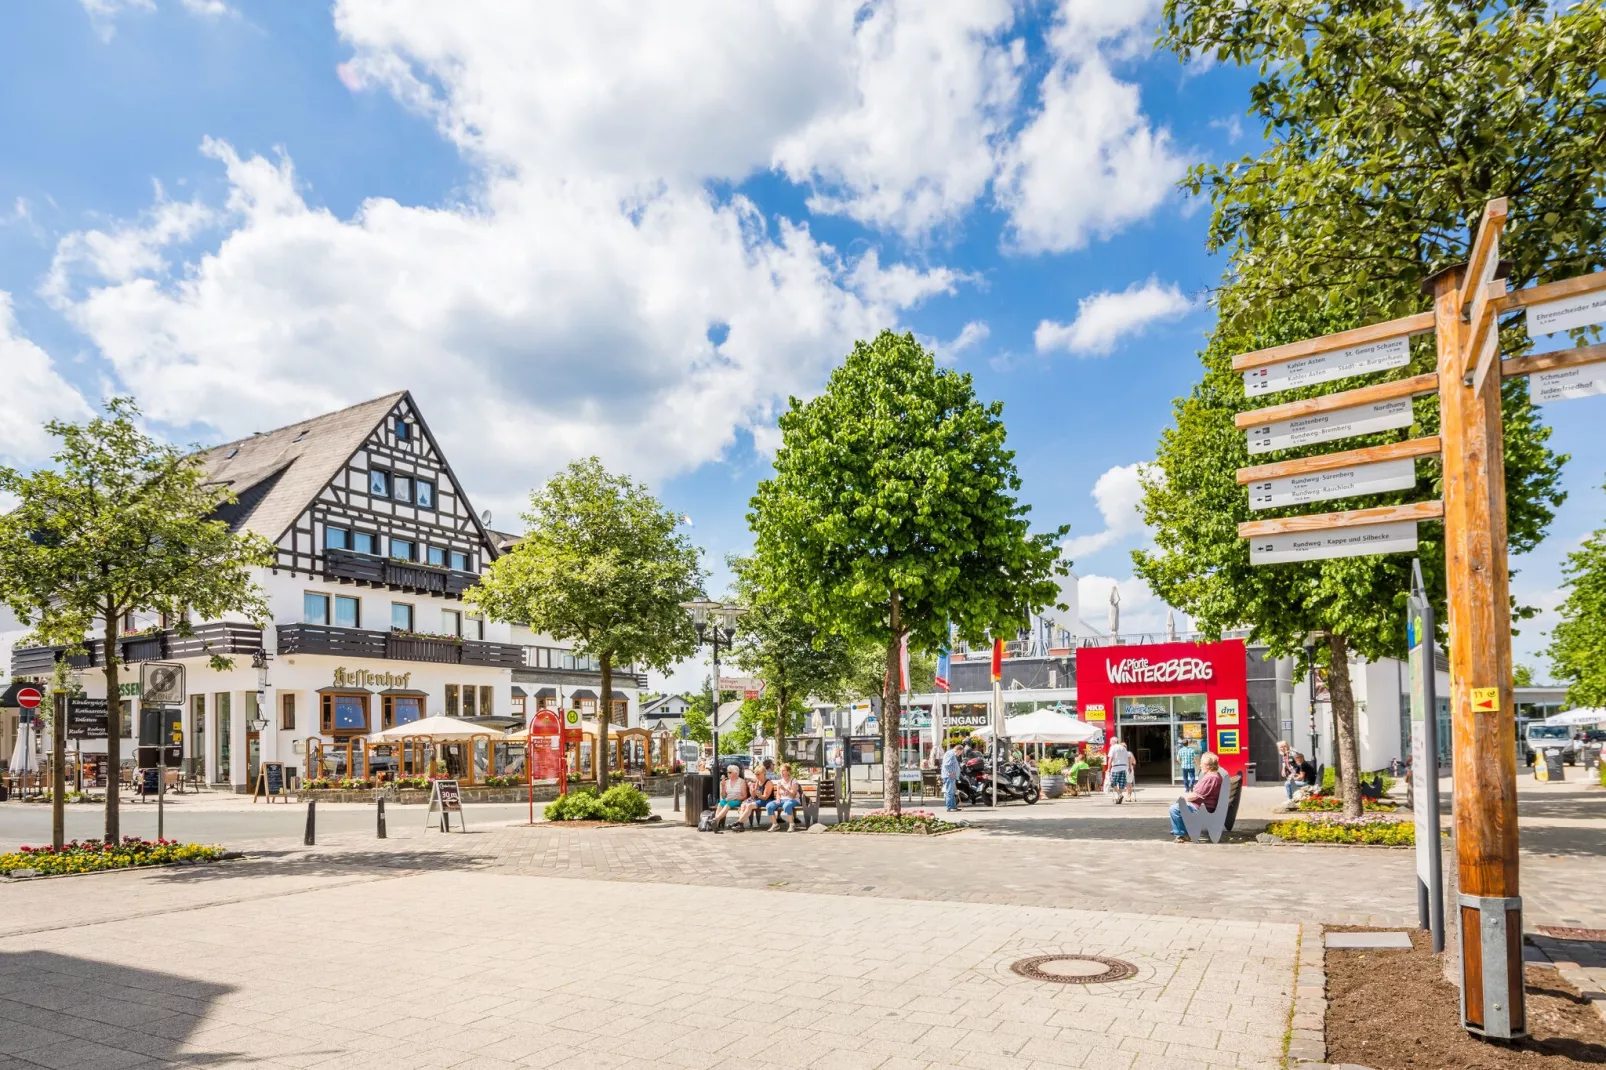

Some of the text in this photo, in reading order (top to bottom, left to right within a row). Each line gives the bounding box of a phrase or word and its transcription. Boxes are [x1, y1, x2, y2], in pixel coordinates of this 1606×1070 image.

[1536, 304, 1590, 320] Ehrenscheider
[1355, 346, 1375, 355] Georg
[1376, 340, 1403, 350] Schanze
[1287, 357, 1326, 370] Kahler Asten
[1287, 373, 1308, 382] Kahler
[1308, 369, 1327, 378] Asten
[1540, 369, 1580, 381] Schmantel
[1540, 380, 1593, 395] Judenfriedhof
[1373, 400, 1406, 412] Nordhang
[1289, 415, 1329, 428] Altastenberg
[1293, 539, 1322, 548] Rundweg
[1327, 537, 1347, 545] Kappe
[1348, 535, 1361, 543] und
[1362, 532, 1390, 541] Silbecke
[1126, 657, 1149, 671] Pforte
[1220, 706, 1235, 714] dm
[942, 716, 987, 725] EINGANG
